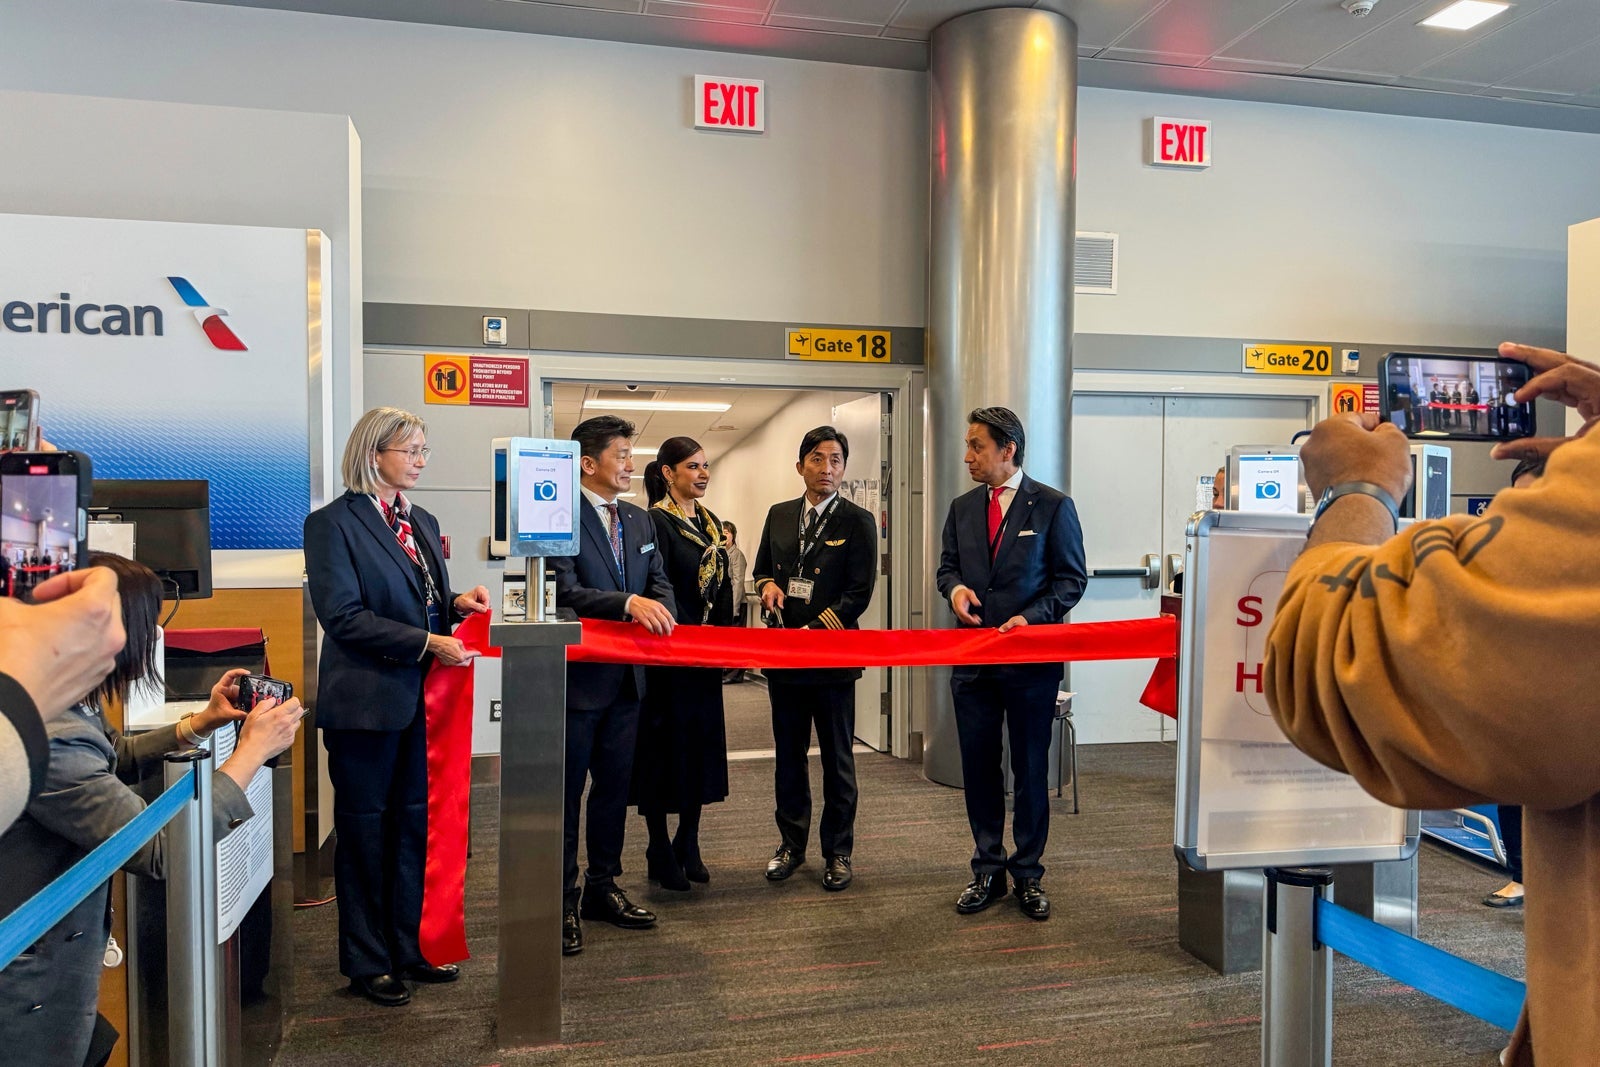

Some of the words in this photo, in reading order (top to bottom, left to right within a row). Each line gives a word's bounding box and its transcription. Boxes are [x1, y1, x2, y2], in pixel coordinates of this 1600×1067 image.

[704, 82, 759, 127] EXIT
[1161, 123, 1207, 163] EXIT
[814, 338, 853, 353] Gate
[856, 334, 887, 359] 18
[1267, 352, 1300, 367] Gate
[1302, 349, 1329, 372] 20
